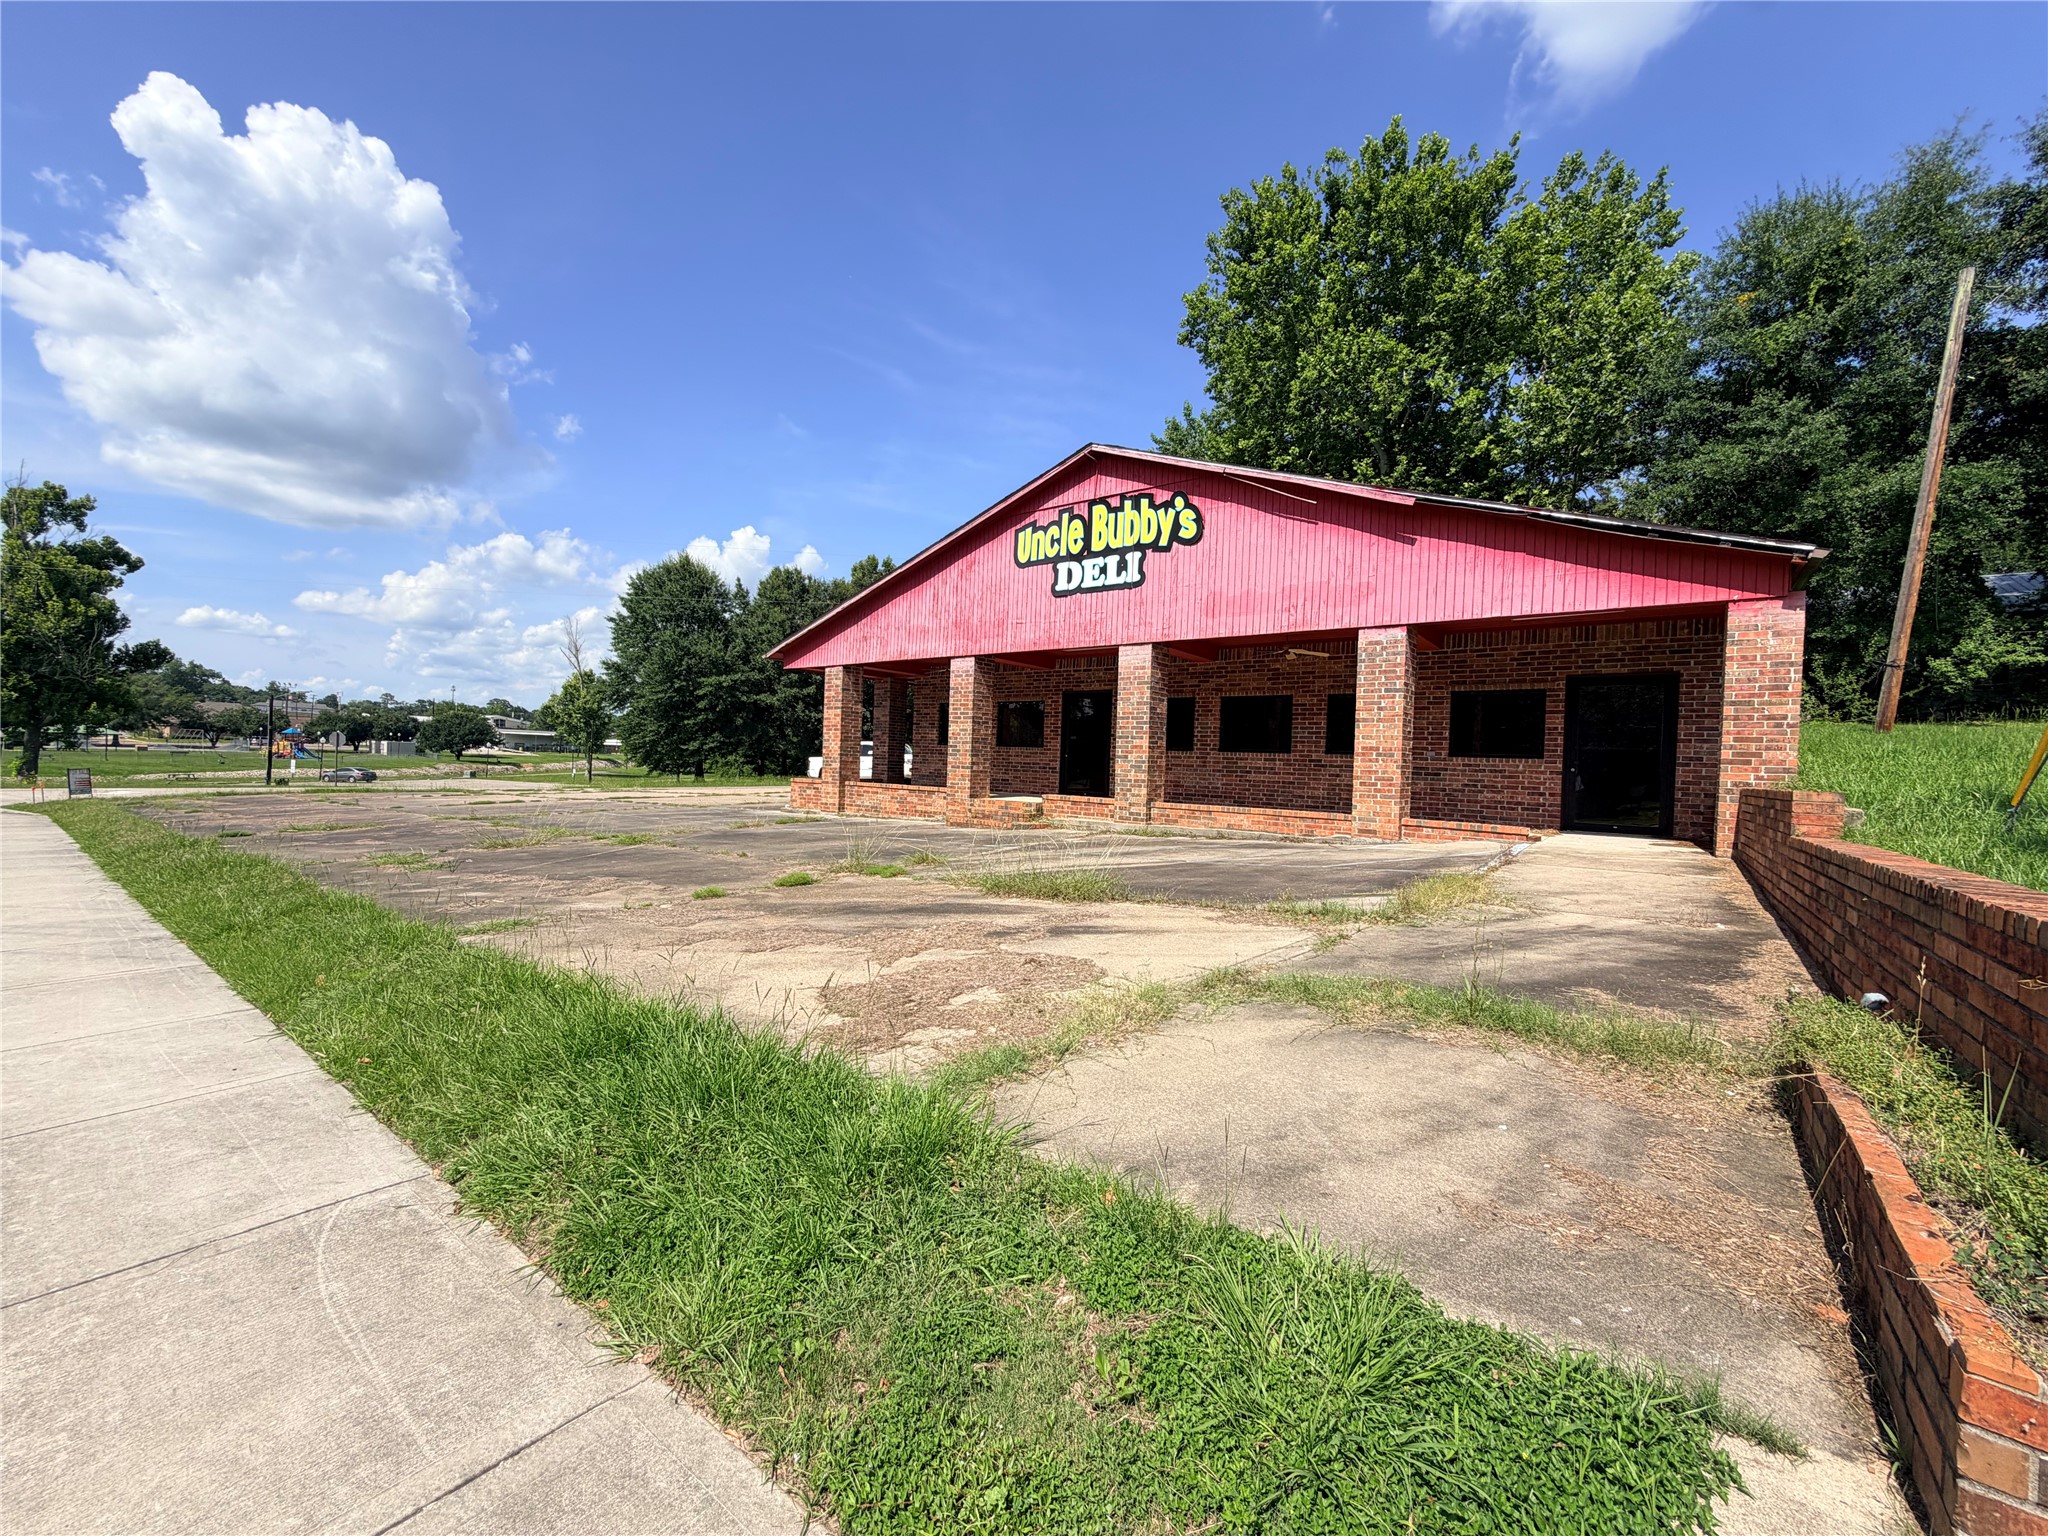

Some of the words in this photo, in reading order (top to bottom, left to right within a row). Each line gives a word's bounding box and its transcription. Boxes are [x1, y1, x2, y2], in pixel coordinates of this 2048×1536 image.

[1017, 512, 1085, 564] Uncle
[1091, 496, 1198, 552] Bubby's
[1054, 551, 1143, 592] DELI
